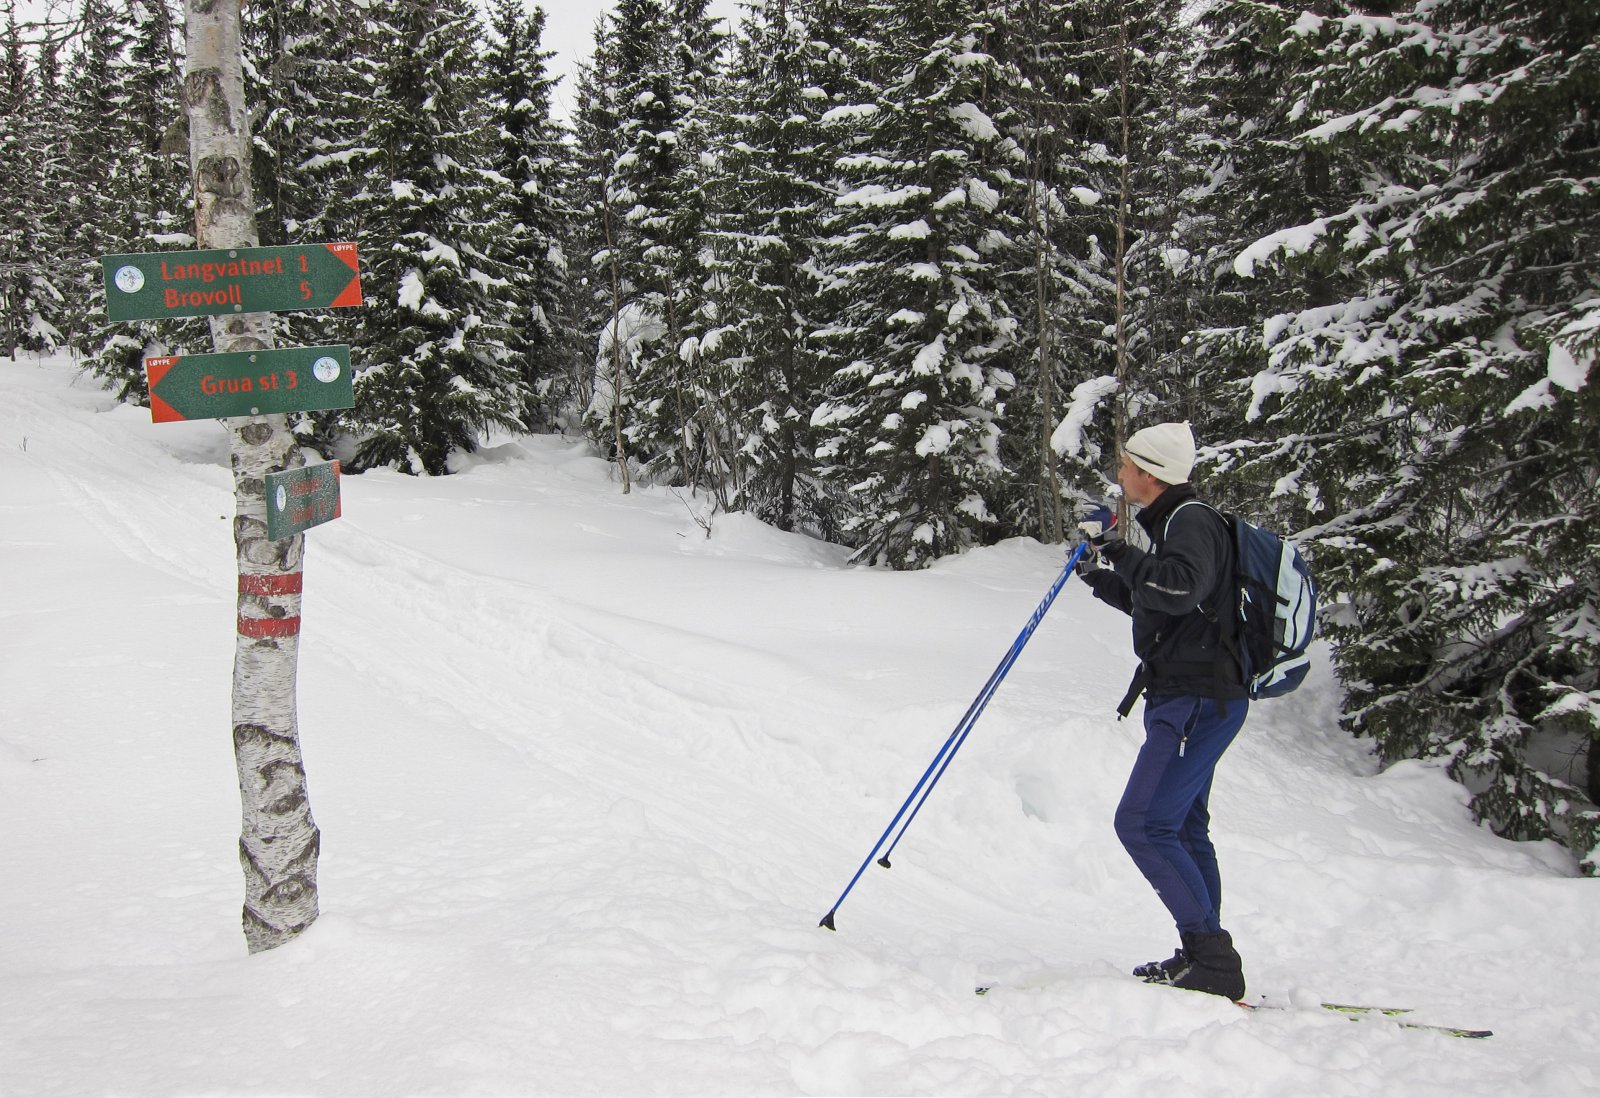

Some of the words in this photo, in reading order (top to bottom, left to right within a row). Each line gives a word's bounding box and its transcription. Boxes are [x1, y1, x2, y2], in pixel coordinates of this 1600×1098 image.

[161, 257, 283, 282] Langvatnet
[299, 255, 308, 272] 1
[165, 284, 242, 308] Brovoll
[300, 281, 312, 300] 5
[201, 375, 253, 394] Grua
[259, 373, 279, 391] st
[285, 371, 298, 389] 3
